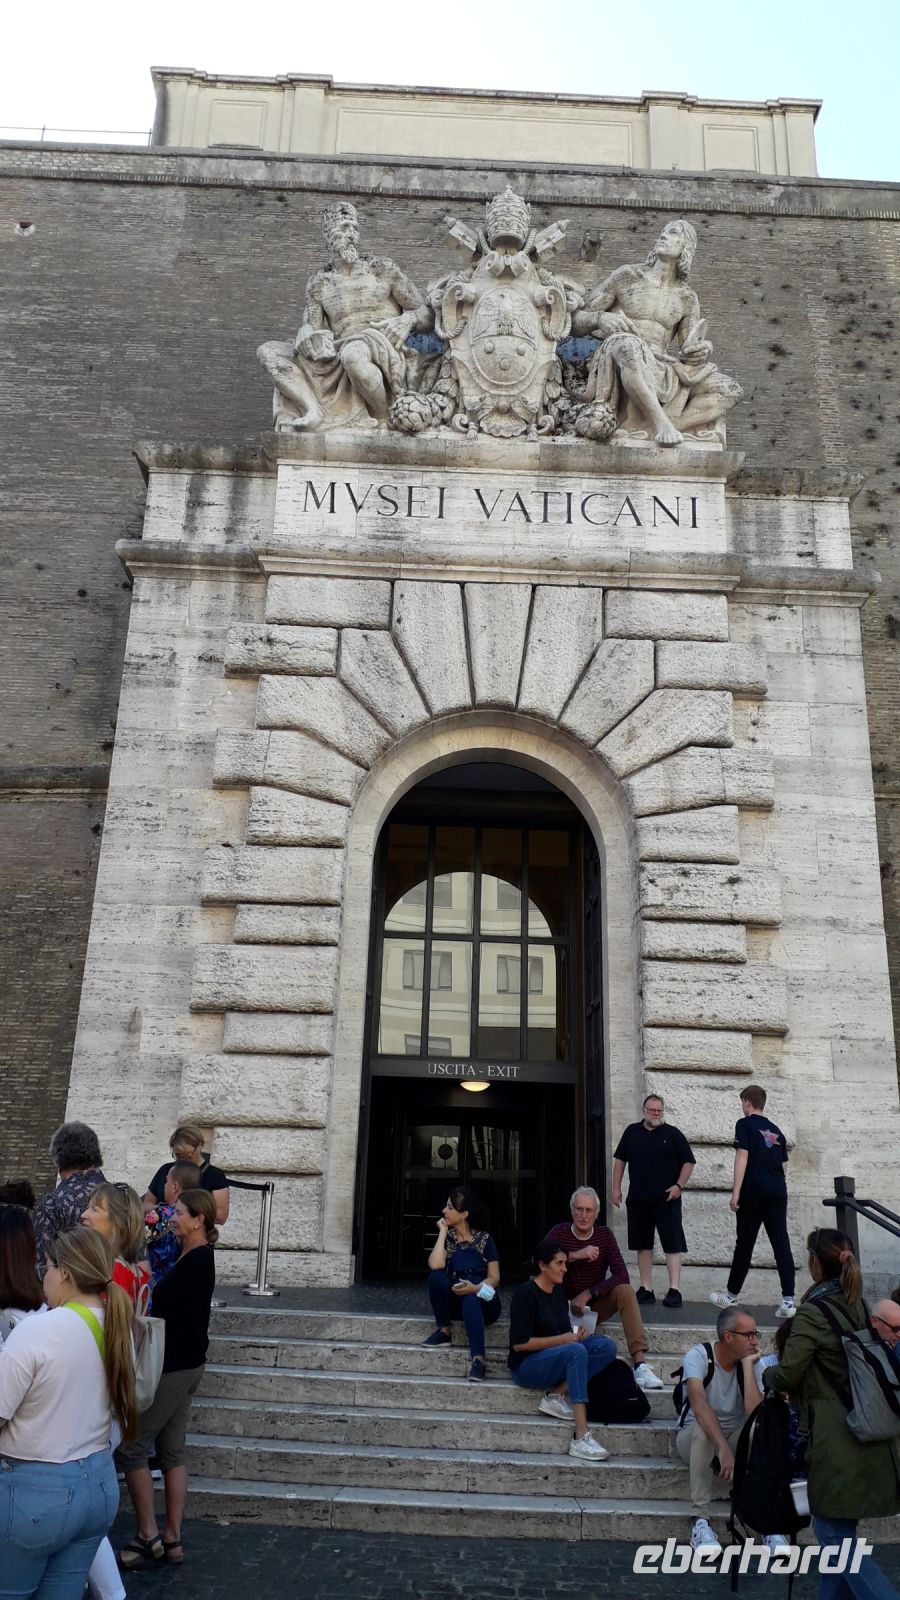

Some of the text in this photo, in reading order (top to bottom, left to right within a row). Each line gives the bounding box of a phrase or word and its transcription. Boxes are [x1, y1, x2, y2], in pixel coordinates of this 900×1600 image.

[303, 480, 699, 529] MVSEI VATICANI
[427, 1063, 476, 1076] USCITA
[487, 1065, 520, 1078] EXIT
